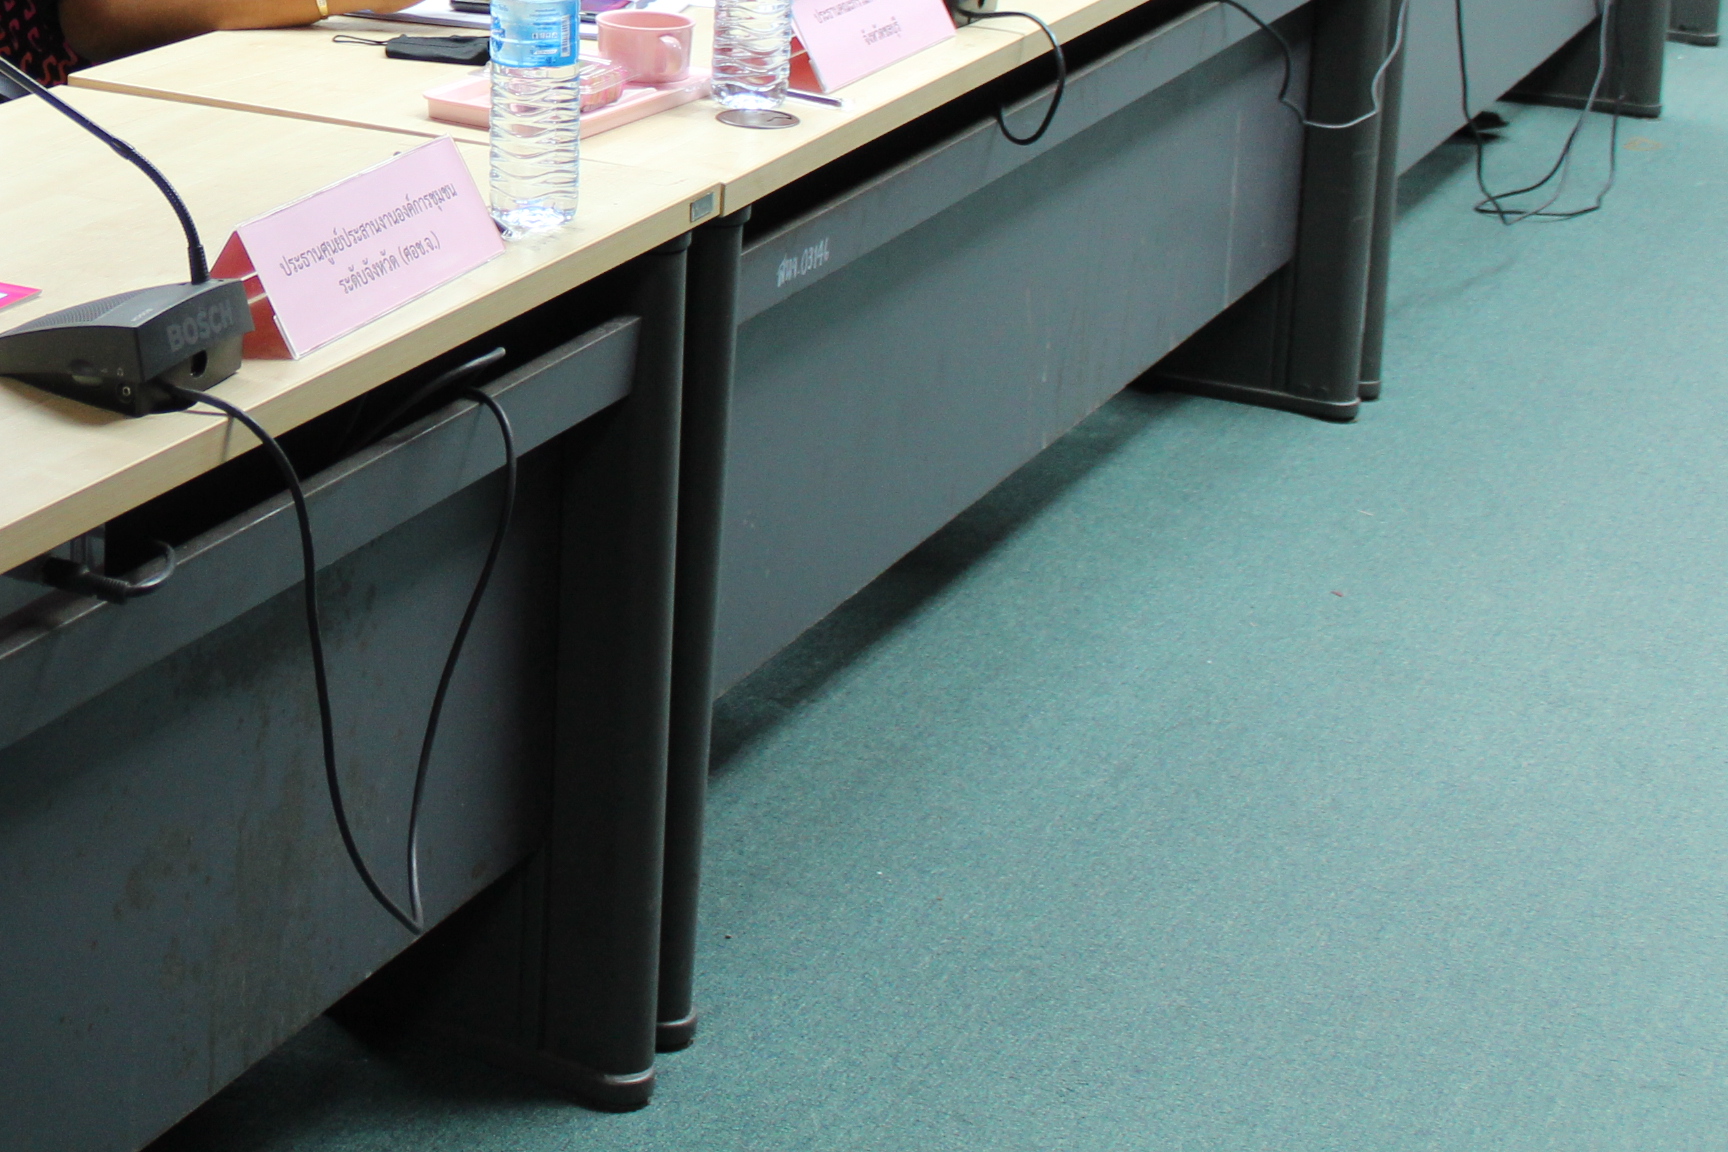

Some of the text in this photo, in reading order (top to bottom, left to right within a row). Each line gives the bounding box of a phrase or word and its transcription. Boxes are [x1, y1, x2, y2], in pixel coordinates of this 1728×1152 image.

[279, 182, 458, 277] ประธานศูนย์ประสานงานองค์การชุมชน
[338, 248, 400, 294] ระดับจังหวัด
[165, 299, 234, 353] BOSCH
